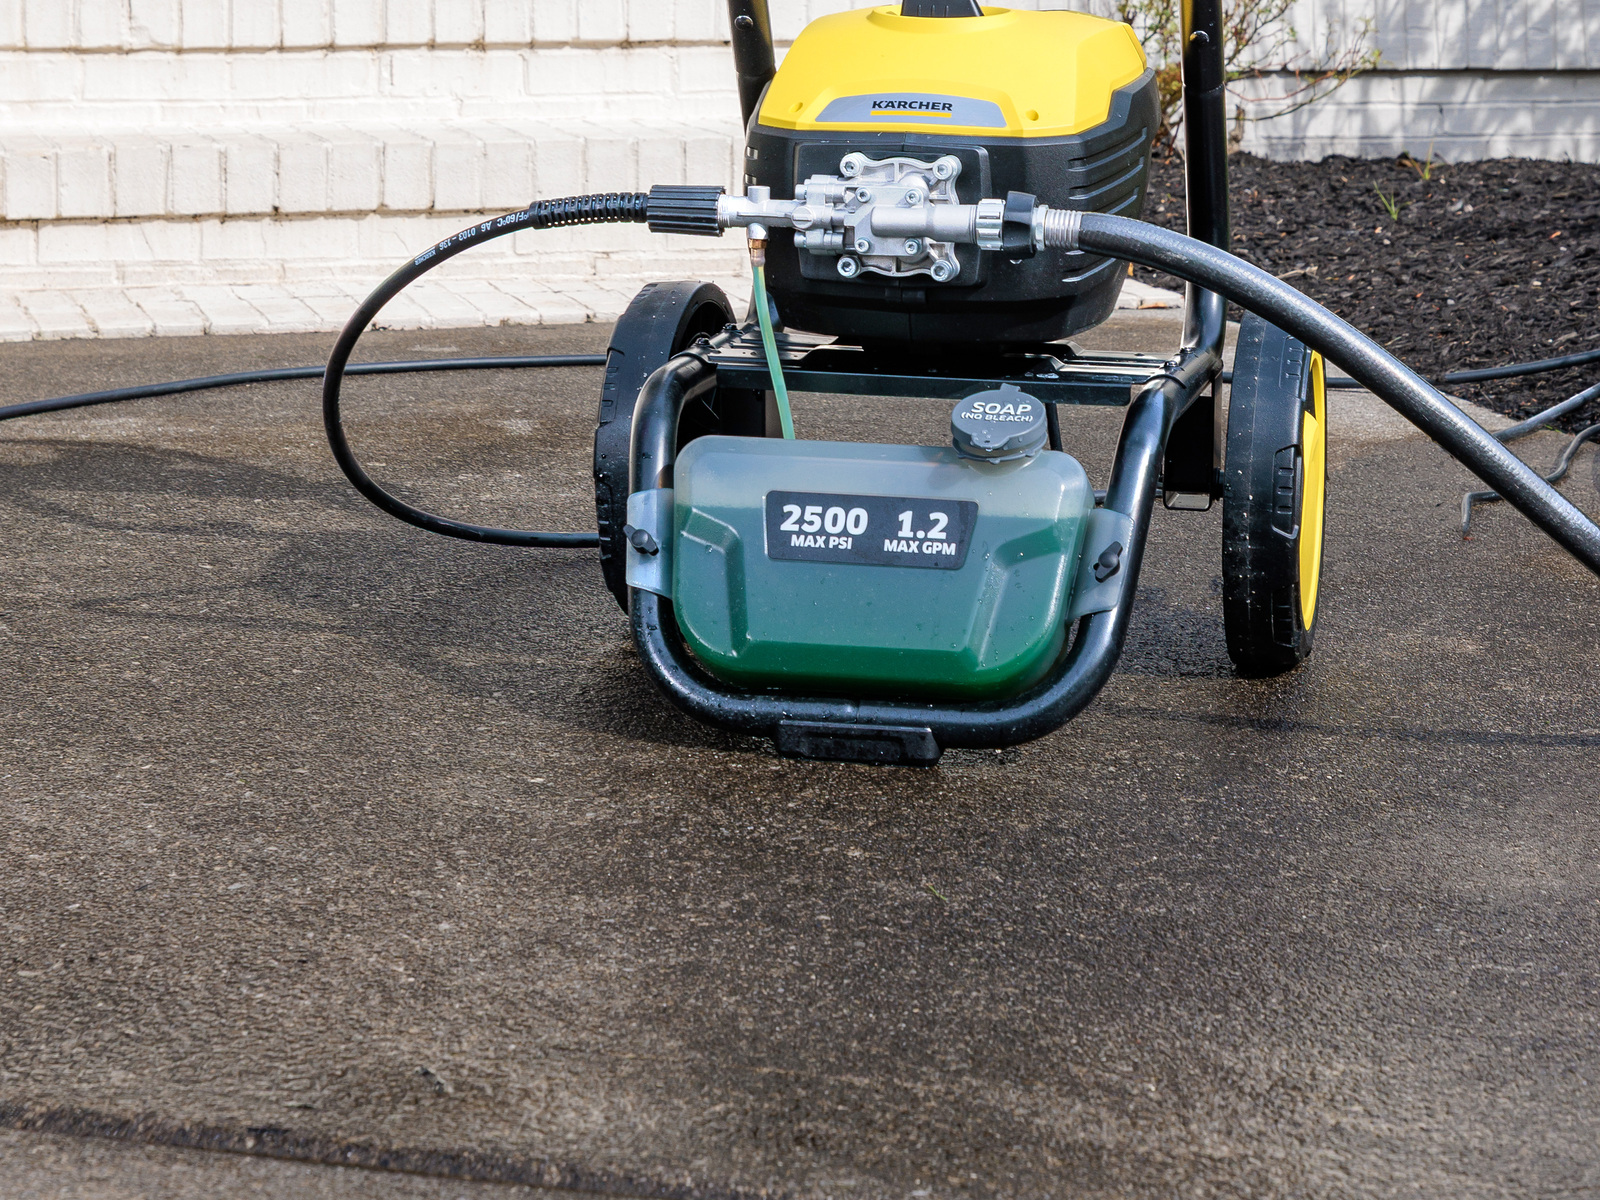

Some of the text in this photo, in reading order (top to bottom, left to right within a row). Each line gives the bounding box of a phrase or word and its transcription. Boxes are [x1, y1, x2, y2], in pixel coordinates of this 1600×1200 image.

[871, 100, 953, 112] KÄRCHER
[970, 401, 1032, 416] SOAP
[961, 411, 1033, 423] (NO BLEACH)
[780, 504, 869, 536] 2500
[897, 510, 949, 540] 1.2
[790, 534, 852, 550] MAX PSI
[883, 539, 956, 556] MAX GPM
